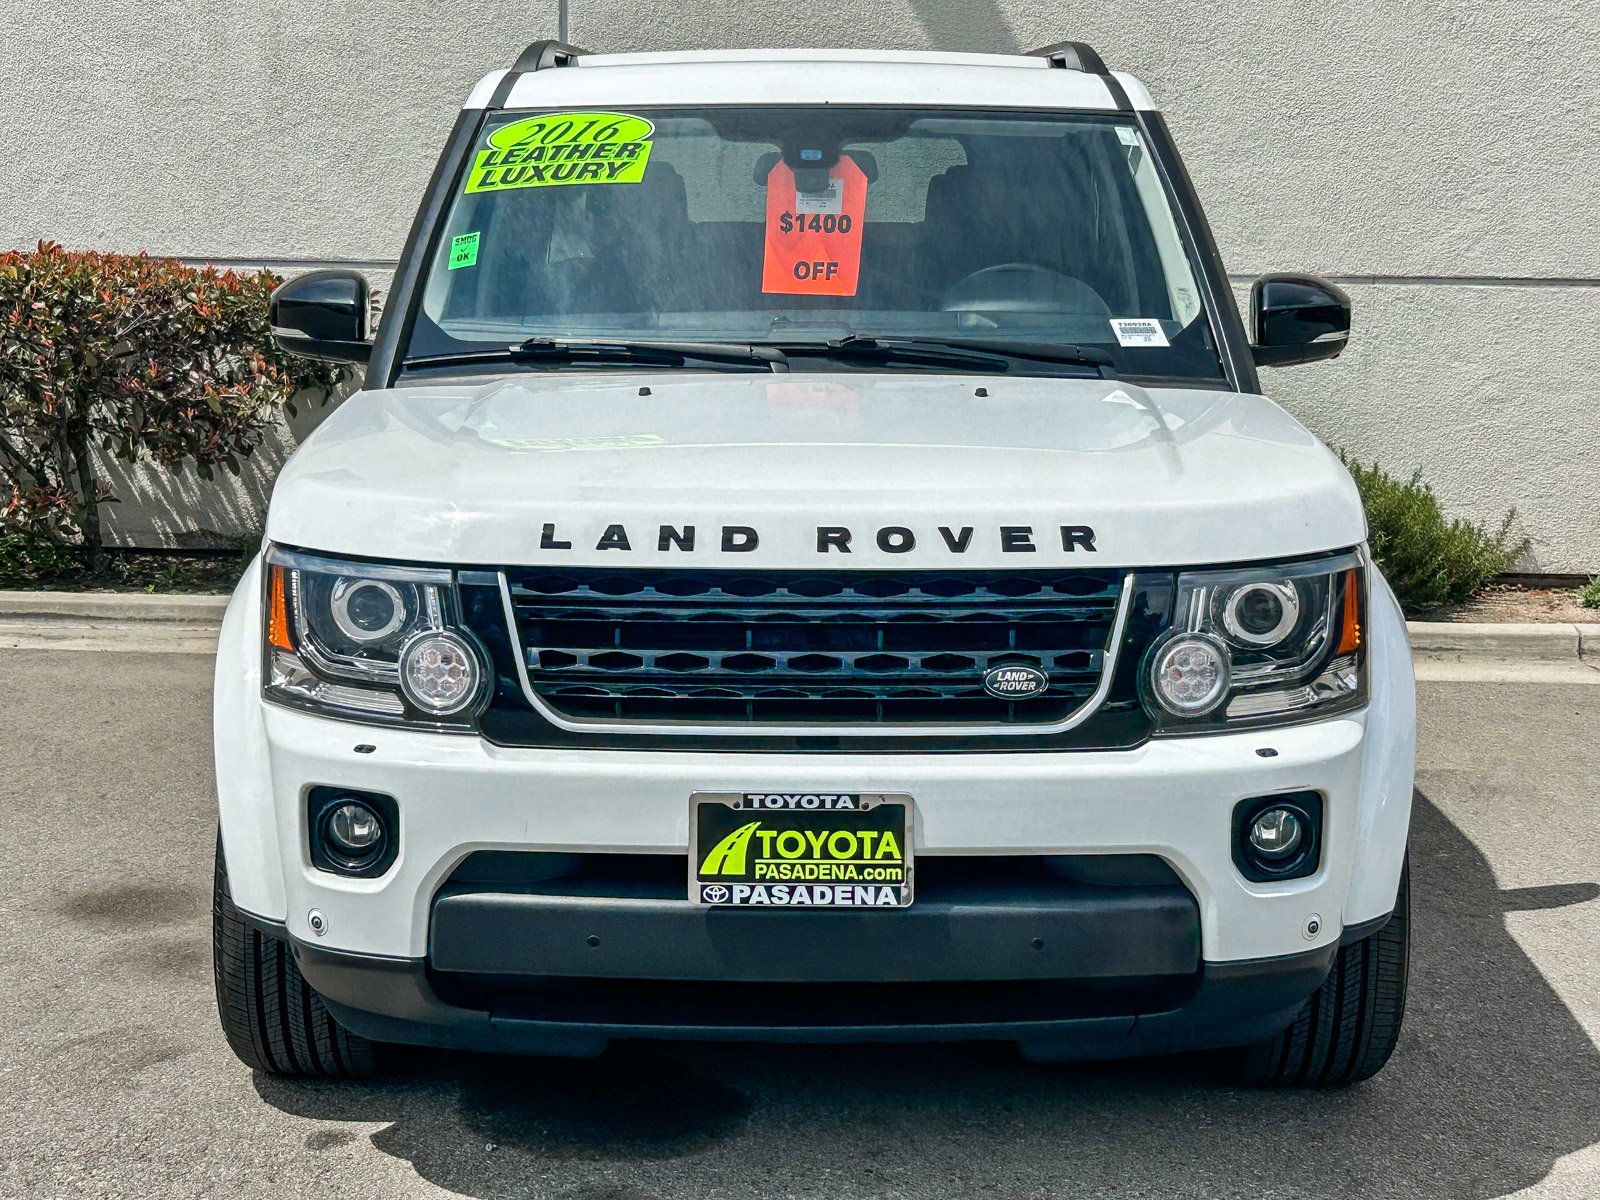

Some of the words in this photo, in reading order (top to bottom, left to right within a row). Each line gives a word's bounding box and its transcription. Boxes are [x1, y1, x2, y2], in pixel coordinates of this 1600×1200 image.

[510, 118, 631, 147] 2016
[480, 142, 645, 169] LEATHER
[477, 161, 635, 190] LUXURY
[779, 210, 852, 234] $1400
[454, 234, 478, 246] SMOG
[456, 252, 470, 262] OK
[793, 261, 838, 281] OFF
[540, 523, 760, 553] LAND
[816, 525, 1098, 553] ROVER
[997, 671, 1028, 681] LAND
[999, 681, 1036, 691] ROVER
[747, 795, 855, 809] TOYOTA
[755, 830, 902, 860] TOYOTA
[754, 864, 903, 881] PASADENA.com
[732, 885, 899, 905] PASADENA
